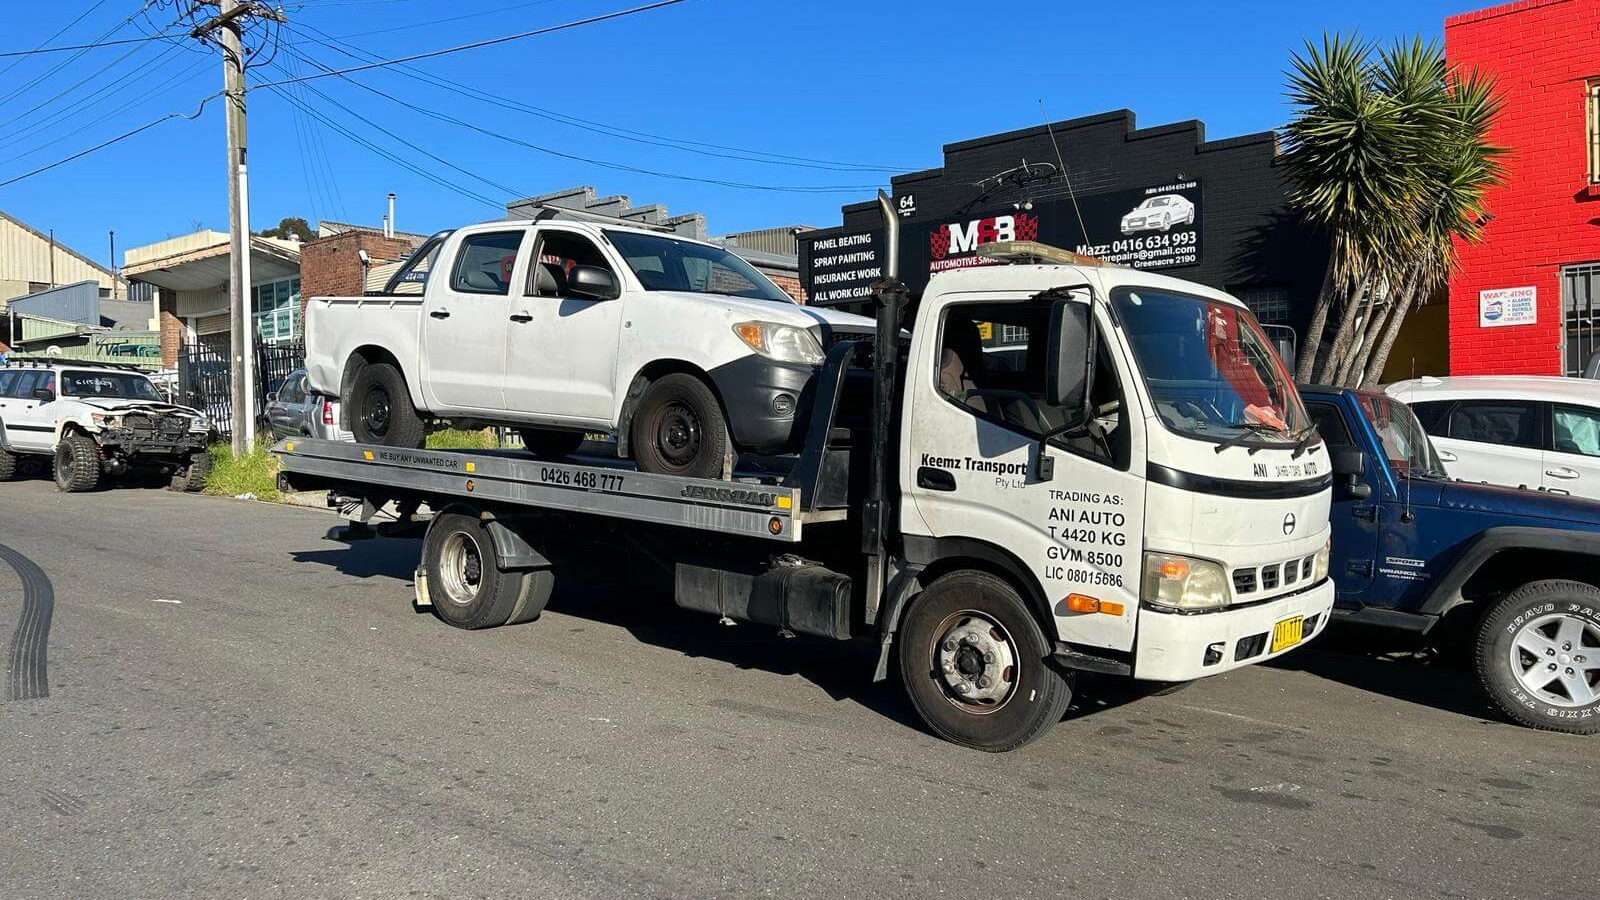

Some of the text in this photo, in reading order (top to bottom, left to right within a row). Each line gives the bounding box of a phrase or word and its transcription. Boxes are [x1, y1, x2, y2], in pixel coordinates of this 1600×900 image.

[900, 195, 914, 208] 64
[814, 233, 871, 251] PANEL BEATING
[1076, 231, 1196, 256] Mazz: 0416 634 993
[814, 250, 875, 268] SPRAY PAINTING
[930, 257, 978, 271] AUTOMOTIVE
[1134, 258, 1174, 268] Greenacre
[1175, 255, 1196, 265] 2190
[814, 268, 881, 285] INSURANCE WORK
[814, 291, 828, 302] ALL
[829, 288, 852, 300] WORK
[380, 452, 388, 460] WE
[400, 454, 412, 462] ANY
[413, 456, 444, 467] UNWANTED
[445, 460, 458, 468] CAR
[921, 453, 1027, 476] Keemz Transport
[541, 467, 624, 491] 0426 468 777
[1253, 463, 1268, 478] ANI
[995, 478, 1026, 489] Pty Ltd
[1049, 489, 1124, 506] TRADING AS:
[1048, 507, 1125, 527] ANI AUTO
[1048, 526, 1126, 546] T 4420 KG
[1047, 546, 1123, 568] GVM 8500
[1387, 557, 1424, 567] SPORT
[1045, 565, 1123, 588] LIC 08015686
[1379, 568, 1430, 578] WRANGLER
[1507, 603, 1555, 634] BRAVO
